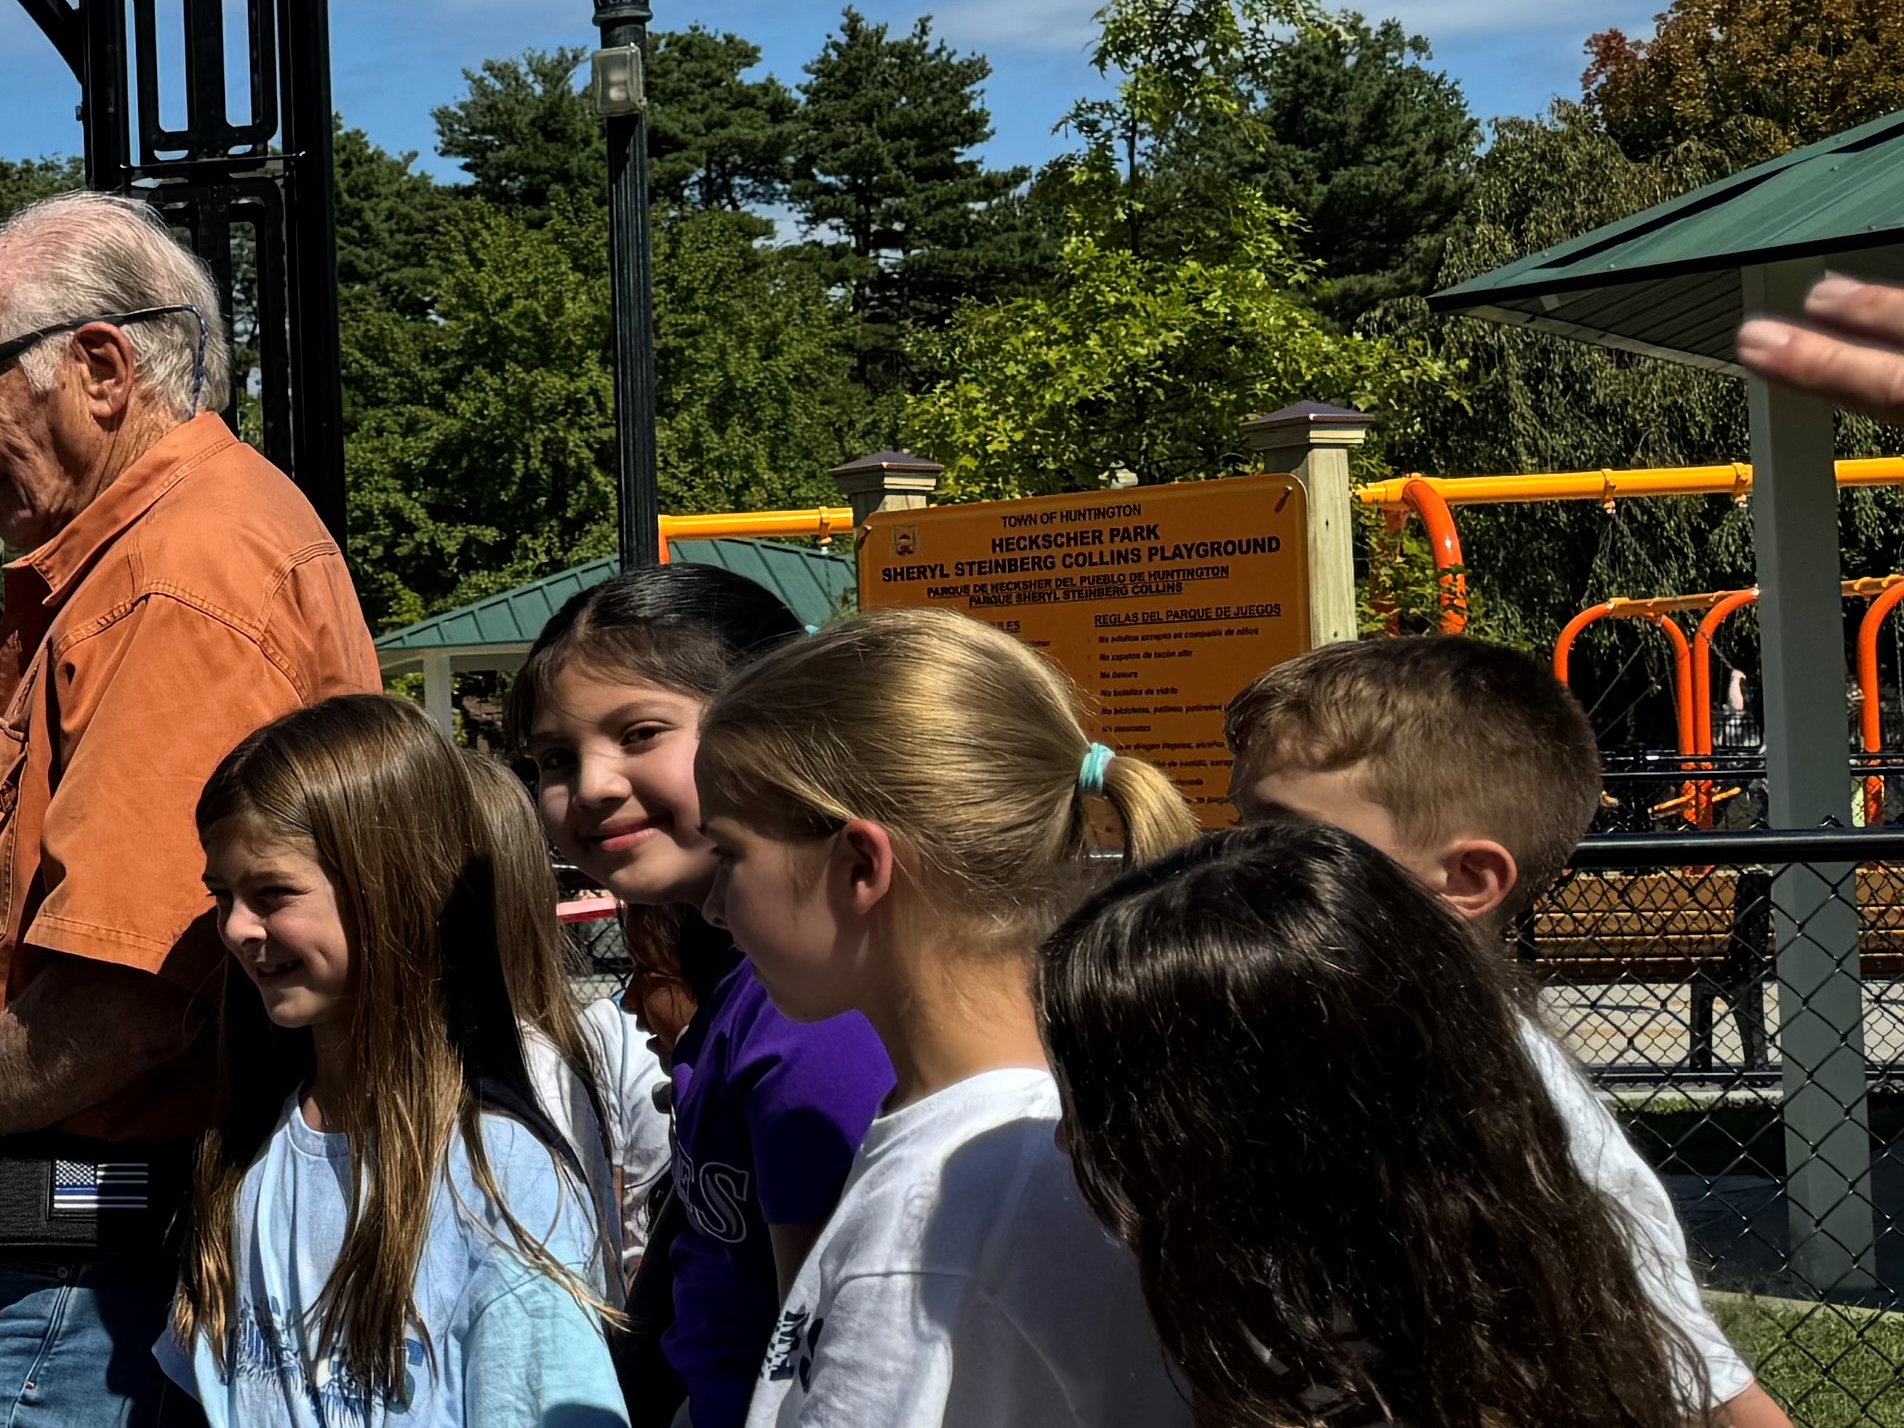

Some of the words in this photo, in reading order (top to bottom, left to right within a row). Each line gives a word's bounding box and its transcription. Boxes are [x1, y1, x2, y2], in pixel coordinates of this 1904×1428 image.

[1001, 513, 1038, 528] TOWN
[1040, 511, 1057, 525] OF
[1060, 503, 1142, 523] HUNTINGTON
[991, 529, 1104, 554] HECKSCHER
[1109, 523, 1160, 544] PARK
[881, 563, 950, 583] SHERYL
[954, 555, 1056, 577] STEINBERG
[1061, 547, 1142, 569] COLLINS
[1147, 536, 1281, 563] PLAYGROUND
[927, 584, 970, 598] PARQUE
[973, 582, 989, 595] DE
[1055, 576, 1077, 589] DEL
[1079, 572, 1127, 587] PUEBLO
[1129, 571, 1145, 583] DE
[1147, 564, 1230, 581] HUNTINGTON
[969, 593, 1014, 607] PARQUE
[1016, 590, 1060, 604] SHERYL
[1062, 585, 1129, 601] STEINBERG
[1131, 582, 1184, 596] COLLINS
[1094, 612, 1140, 626] REGLAS
[1141, 610, 1163, 623] DEL
[1165, 607, 1213, 621] PARQUE
[1215, 605, 1231, 618] DE
[1233, 603, 1282, 618] JUEGOS
